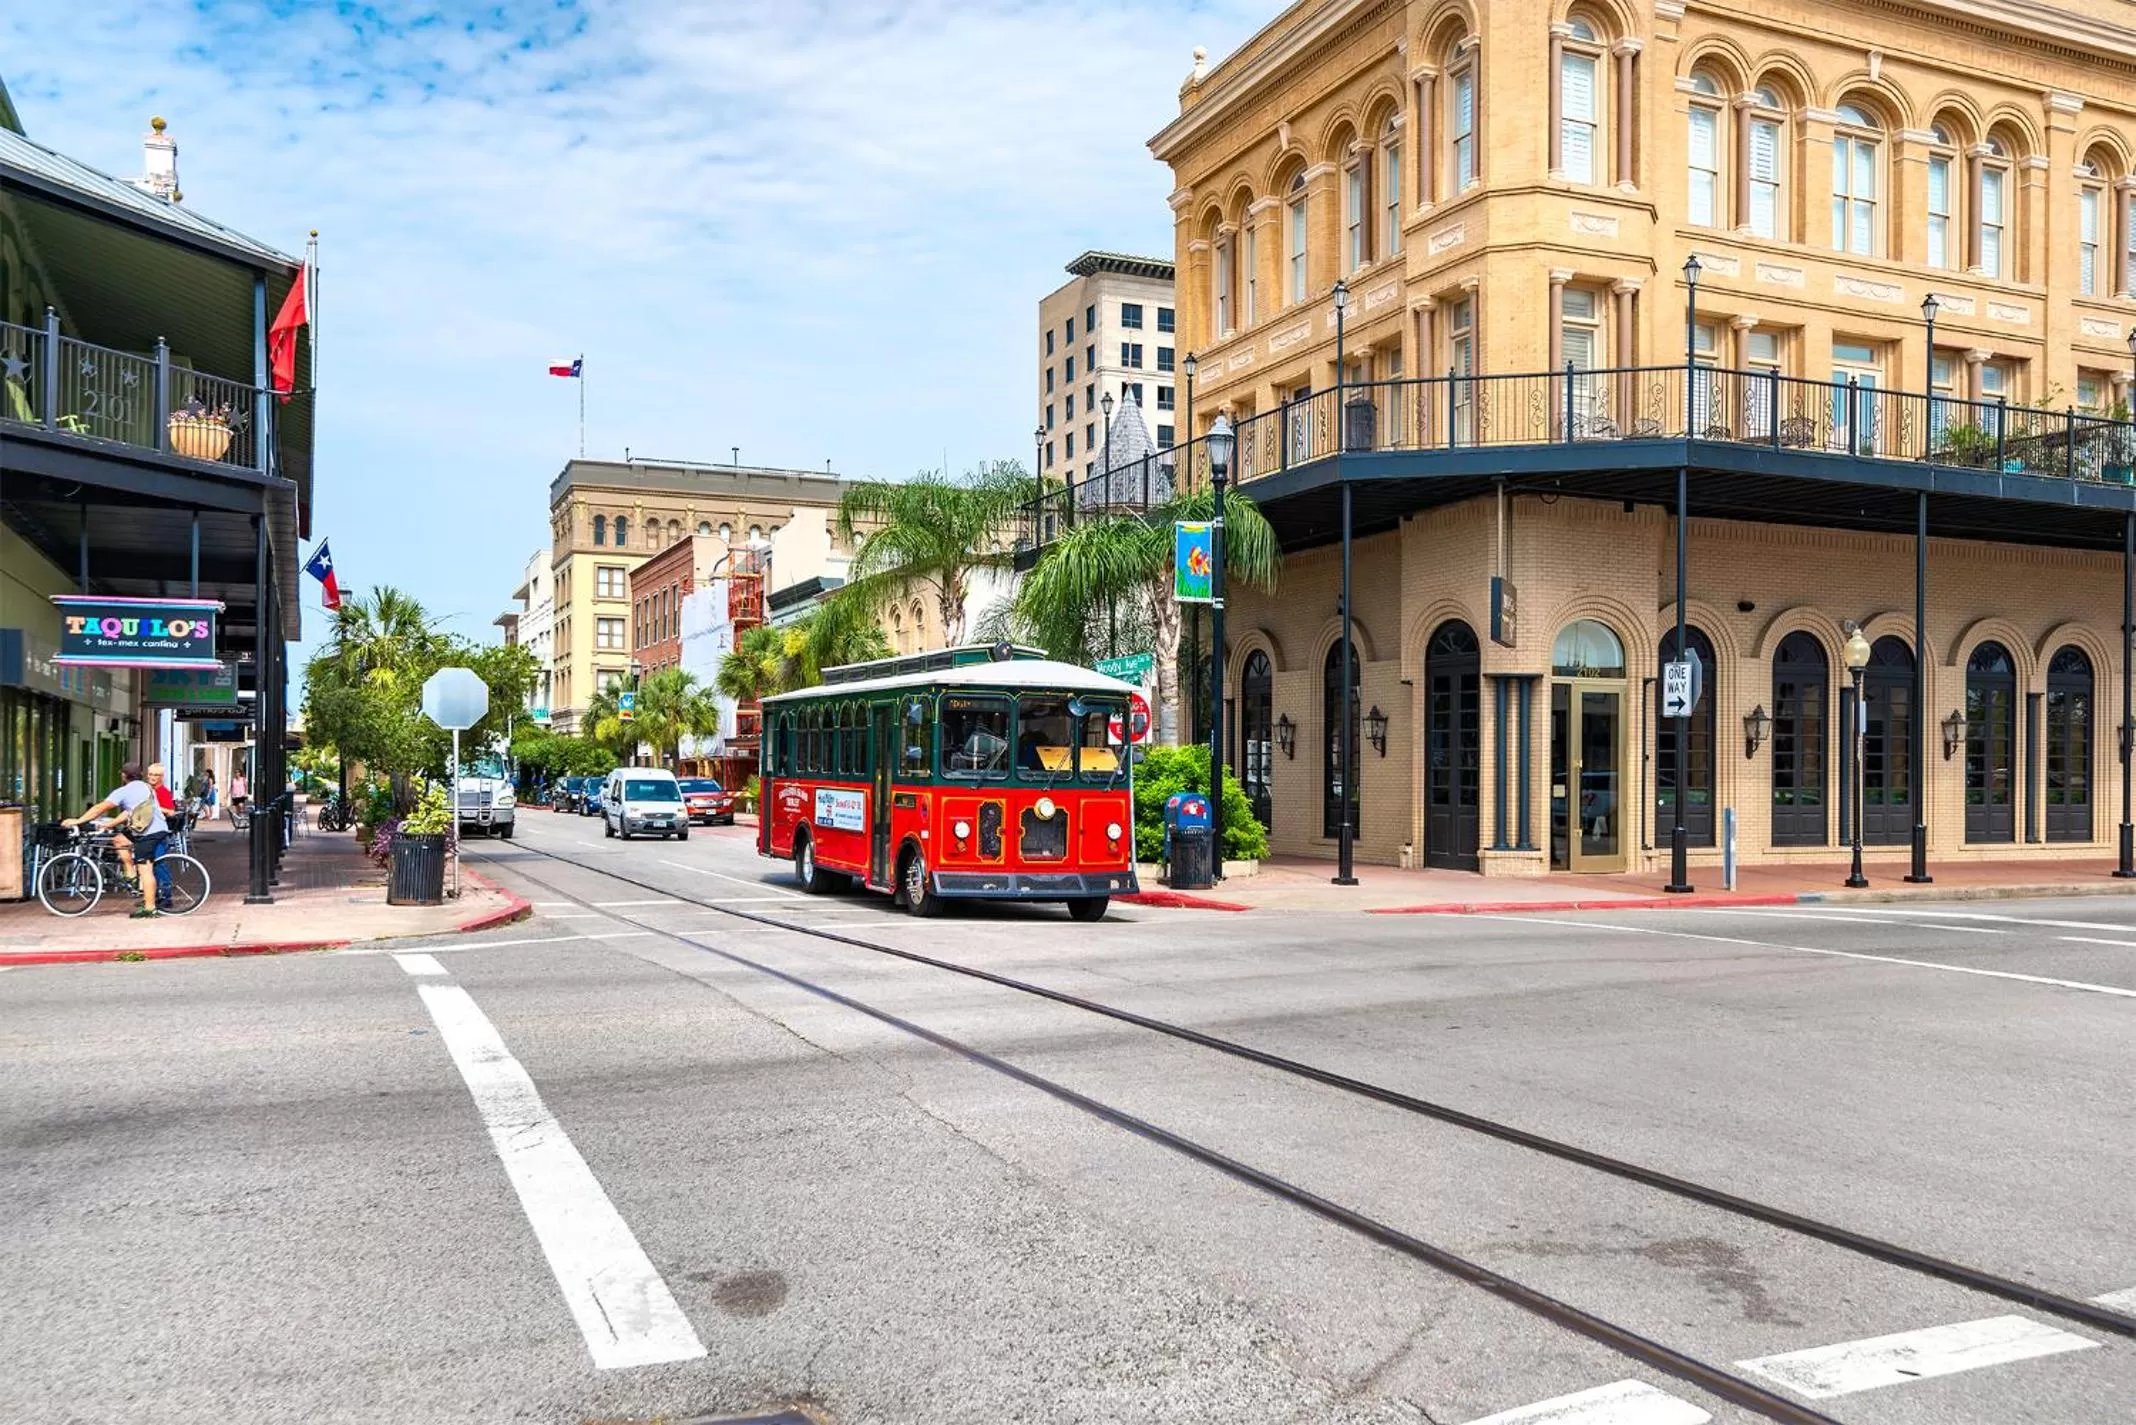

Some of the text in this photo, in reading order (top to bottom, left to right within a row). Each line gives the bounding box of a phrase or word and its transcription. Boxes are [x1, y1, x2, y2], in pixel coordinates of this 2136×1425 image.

[84, 390, 133, 425] 2101
[66, 616, 209, 638] TAQUILO'S
[1668, 667, 1687, 680] ONE
[1668, 681, 1687, 693] WAY
